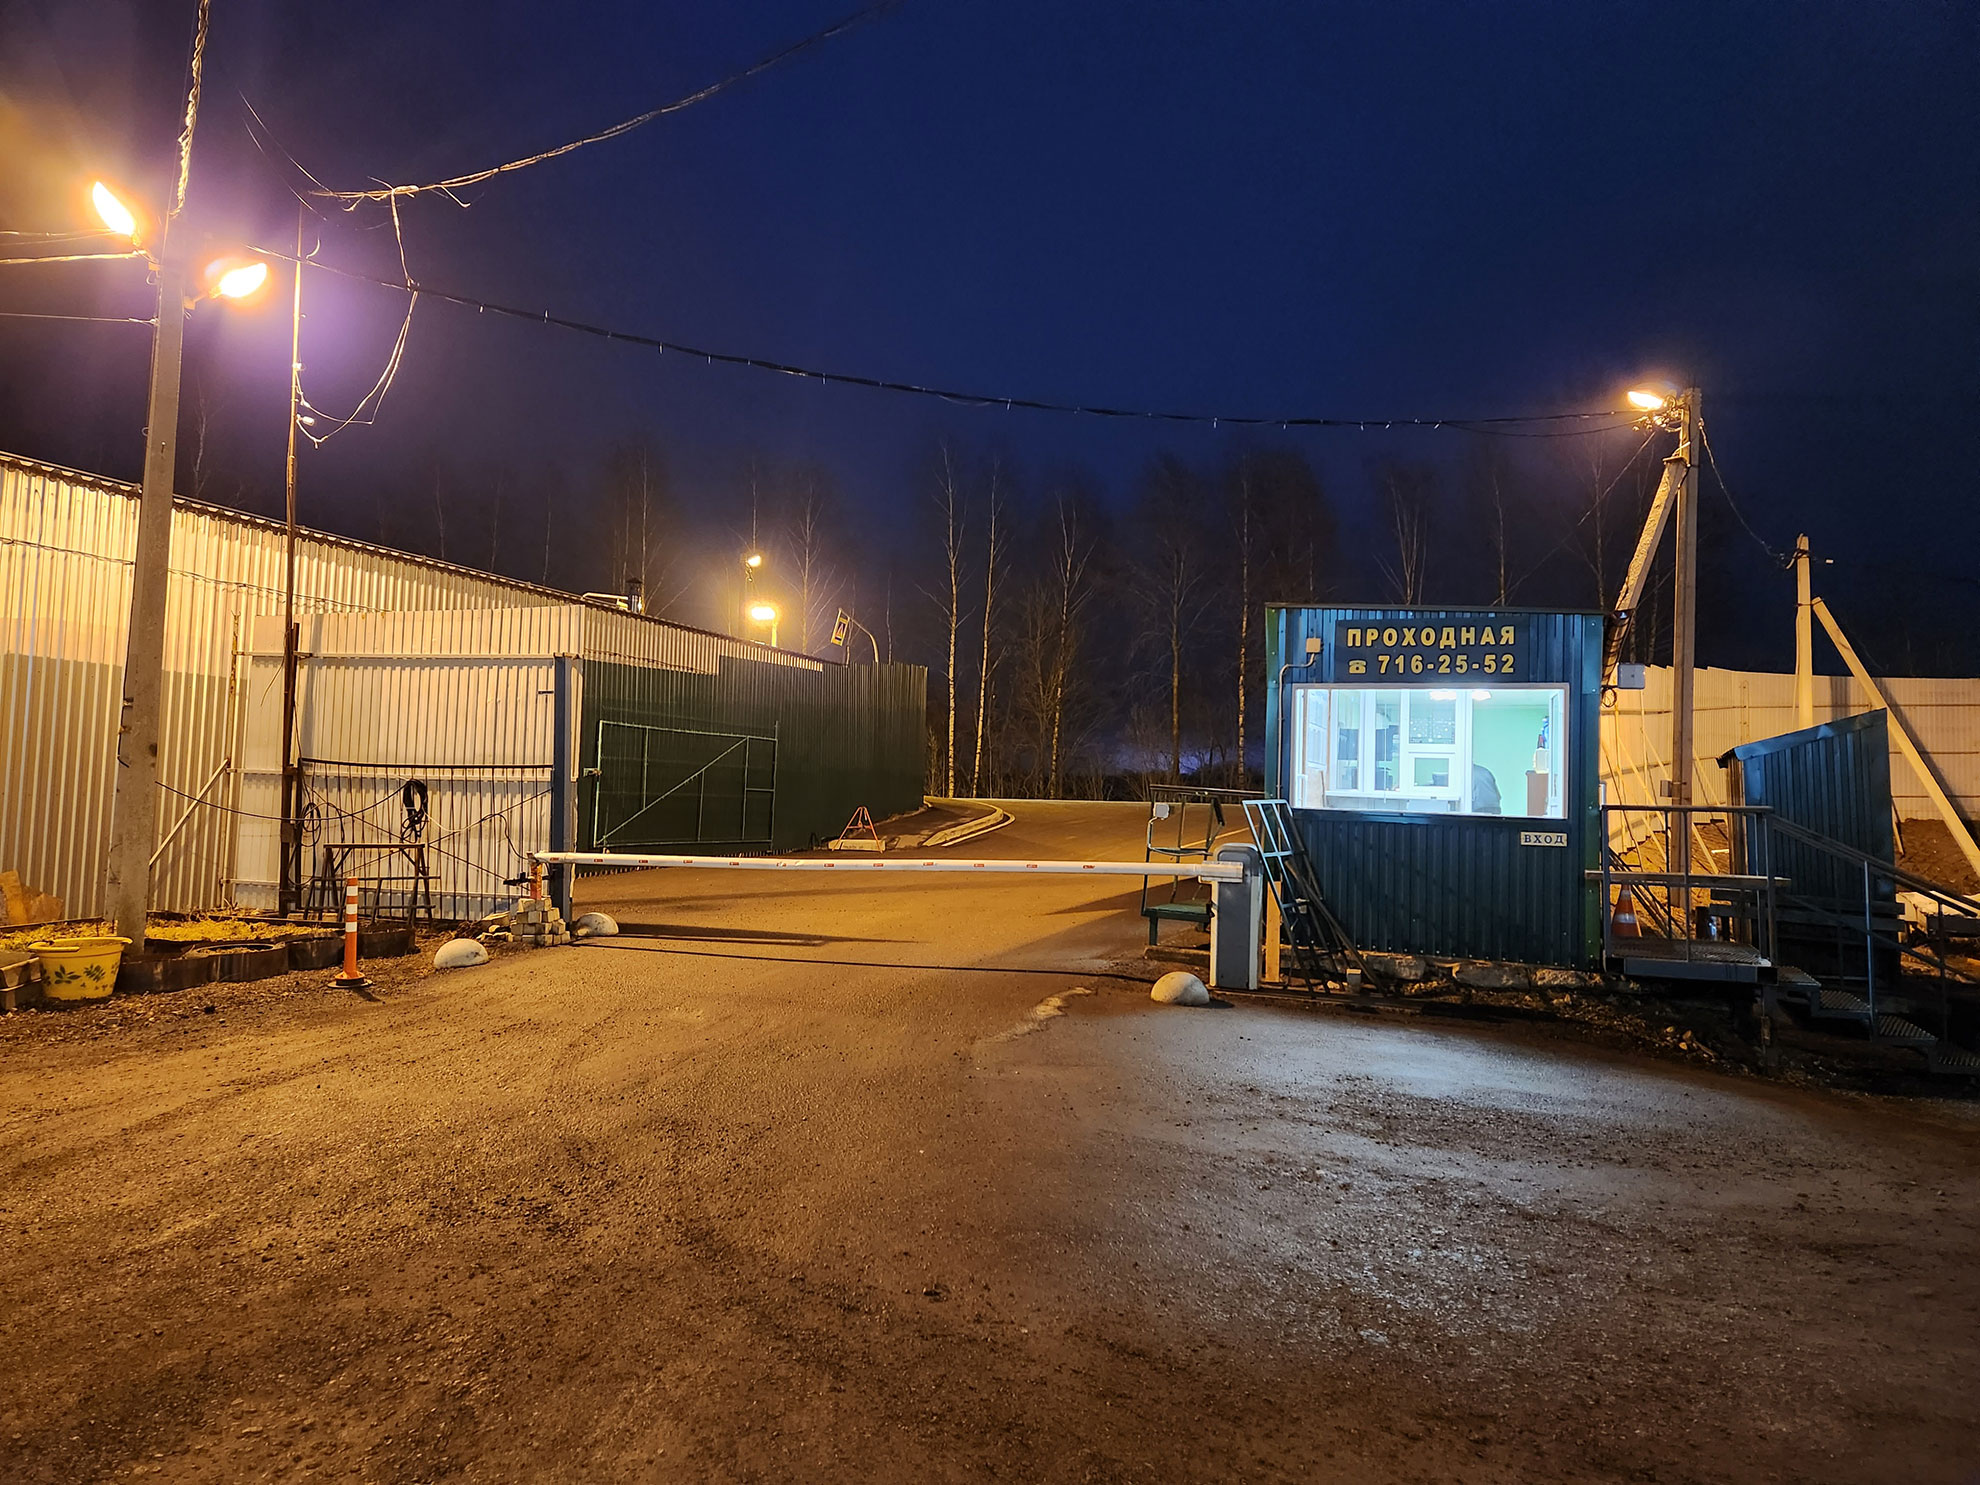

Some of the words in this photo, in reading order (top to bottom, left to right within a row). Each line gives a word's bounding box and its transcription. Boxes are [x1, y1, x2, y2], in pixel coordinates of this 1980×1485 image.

[1346, 625, 1516, 649] ПРОХОДНАЯ
[1377, 654, 1515, 674] 716-25-52
[1524, 834, 1564, 845] ВХОД
